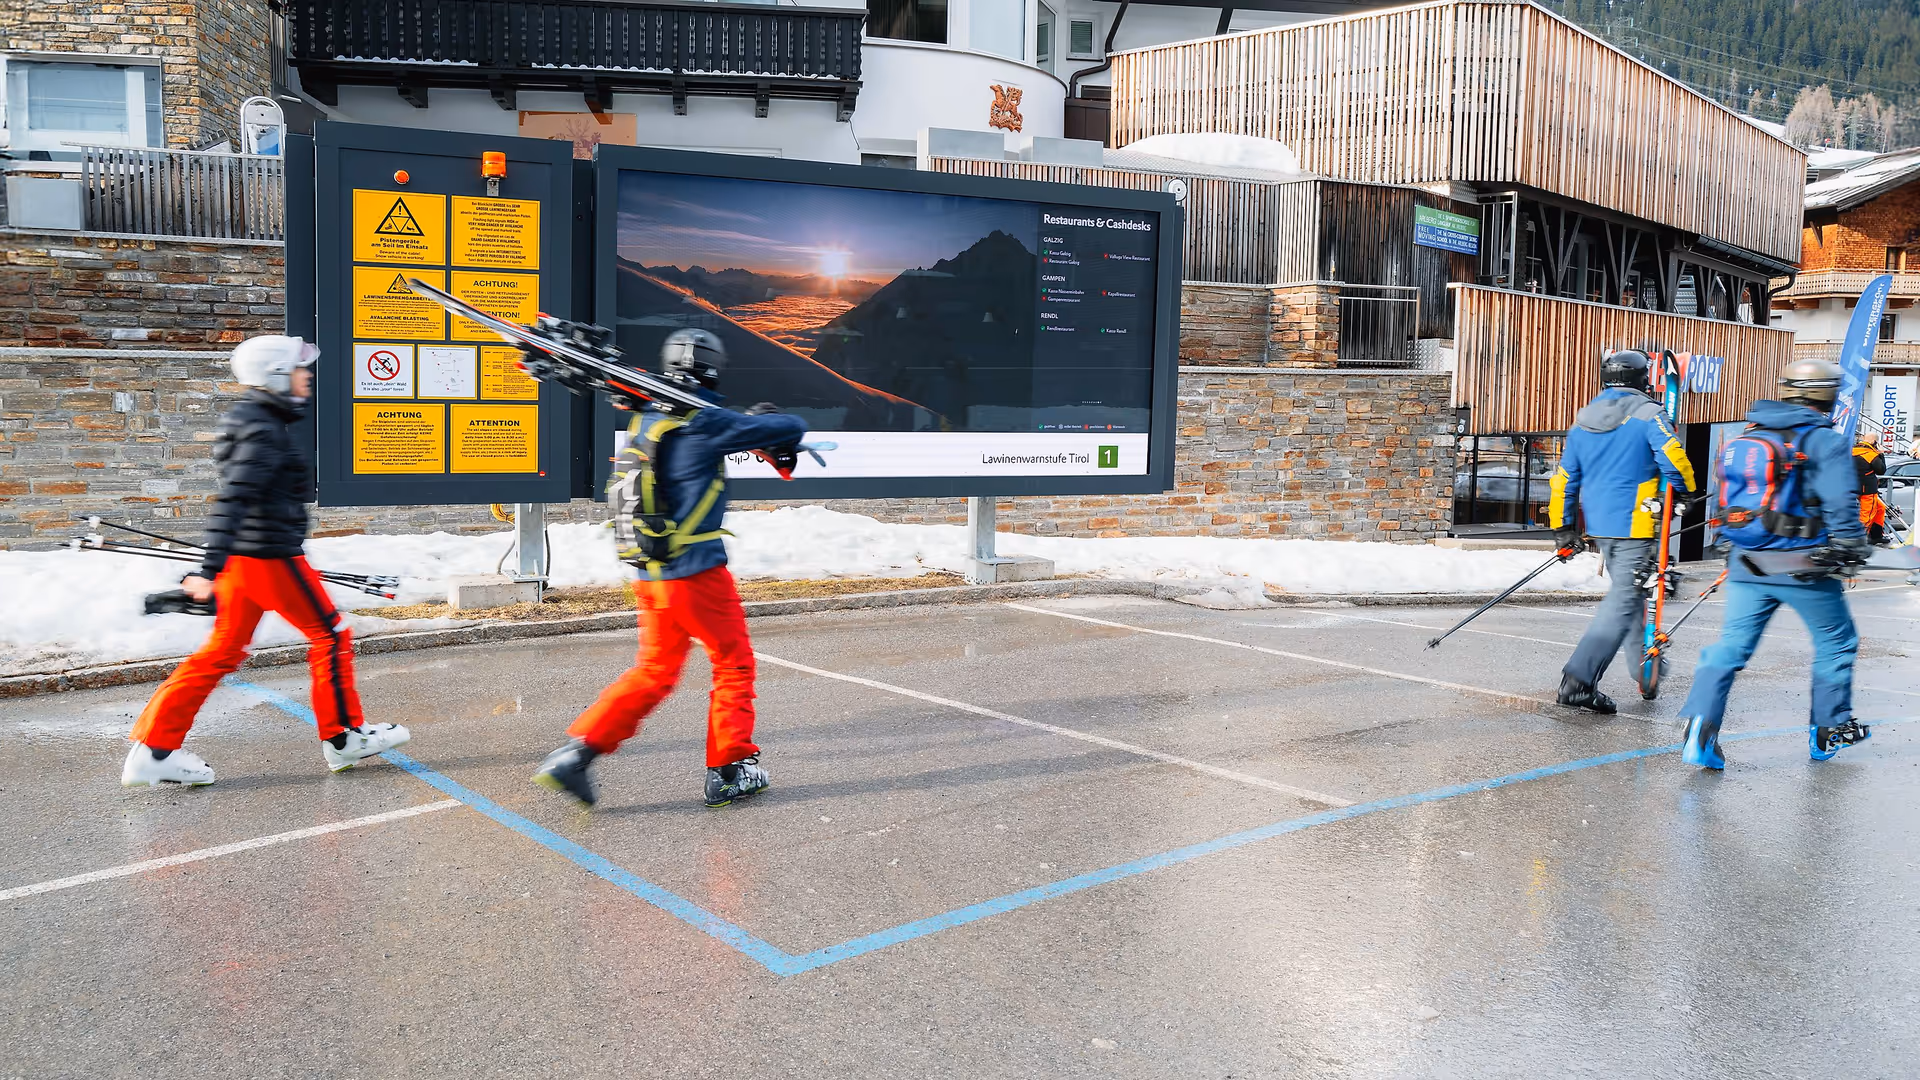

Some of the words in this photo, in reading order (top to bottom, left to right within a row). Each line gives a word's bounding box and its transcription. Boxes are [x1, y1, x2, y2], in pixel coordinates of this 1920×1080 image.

[1044, 214, 1095, 227] Restaurants
[1096, 218, 1105, 228] &
[1106, 219, 1151, 231] Cashdesks
[1896, 409, 1907, 441] RENT
[983, 453, 1066, 464] Lawinenwarnstufe
[1069, 453, 1089, 463] Tirol
[1104, 450, 1111, 464] 1
